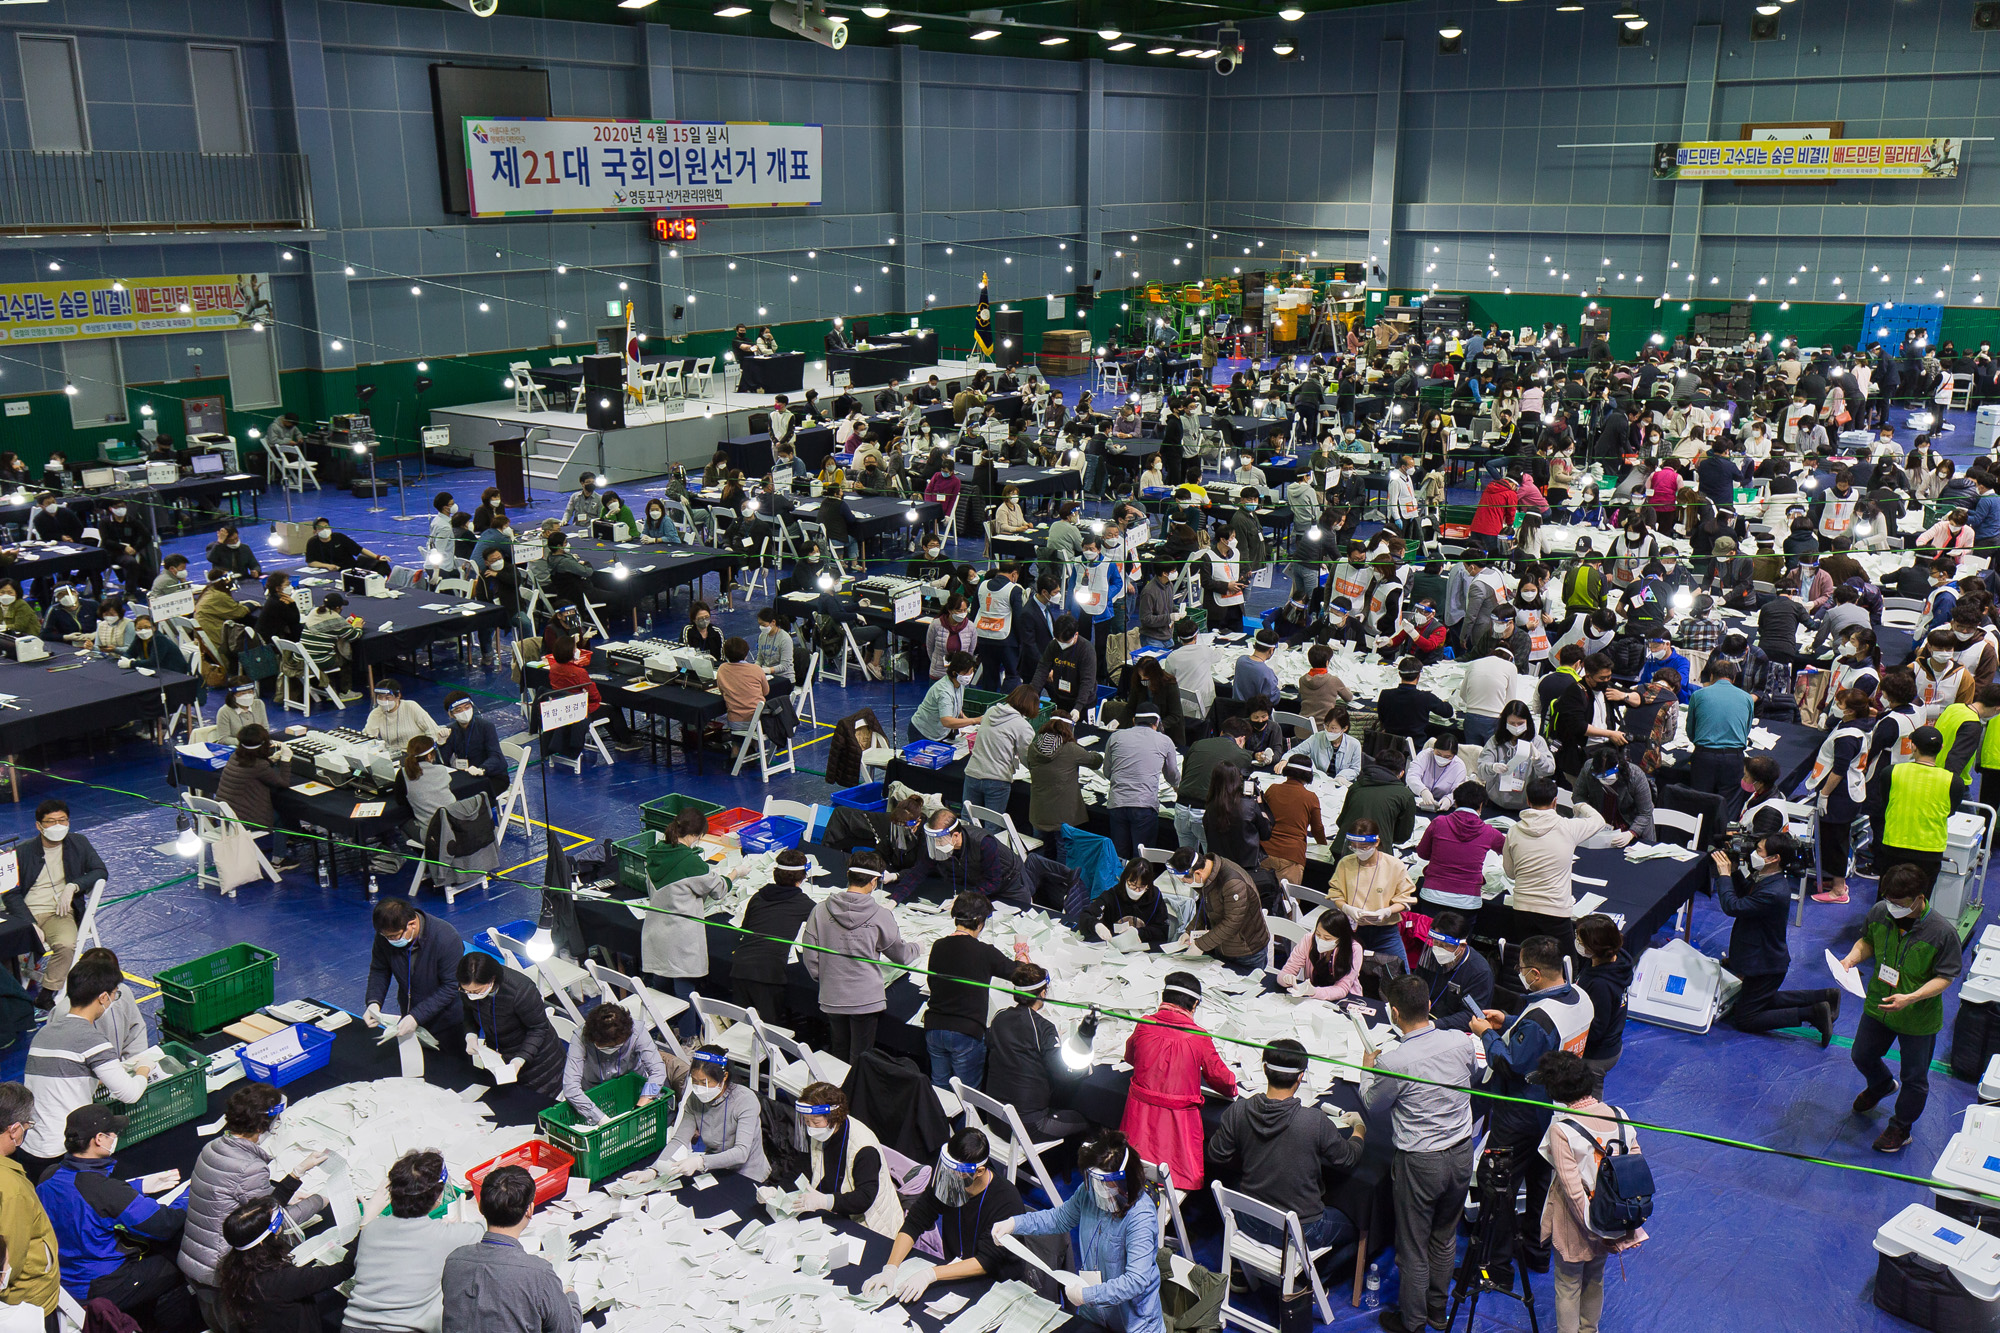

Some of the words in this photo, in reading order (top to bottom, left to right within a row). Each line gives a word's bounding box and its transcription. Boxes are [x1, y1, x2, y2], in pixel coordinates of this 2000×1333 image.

[593, 126, 642, 143] 2020년
[647, 126, 668, 144] 4월
[673, 127, 701, 144] 15일
[706, 127, 729, 144] 실시
[1677, 148, 1720, 165] 배드민턴
[1723, 147, 1768, 165] 고수되는
[1771, 147, 1794, 164] 숨은
[1797, 147, 1829, 164] 비결!!
[1832, 146, 1881, 163] 배드민턴
[1884, 146, 1932, 163] 필라테스
[491, 146, 590, 188] 제21대
[601, 146, 757, 187] 국회의원선거
[766, 147, 811, 184] 개표
[629, 189, 723, 204] 영등포구선거관리위원회
[59, 290, 89, 319] 숨은
[91, 289, 132, 316] 비결!!
[192, 285, 245, 311] 필라테스
